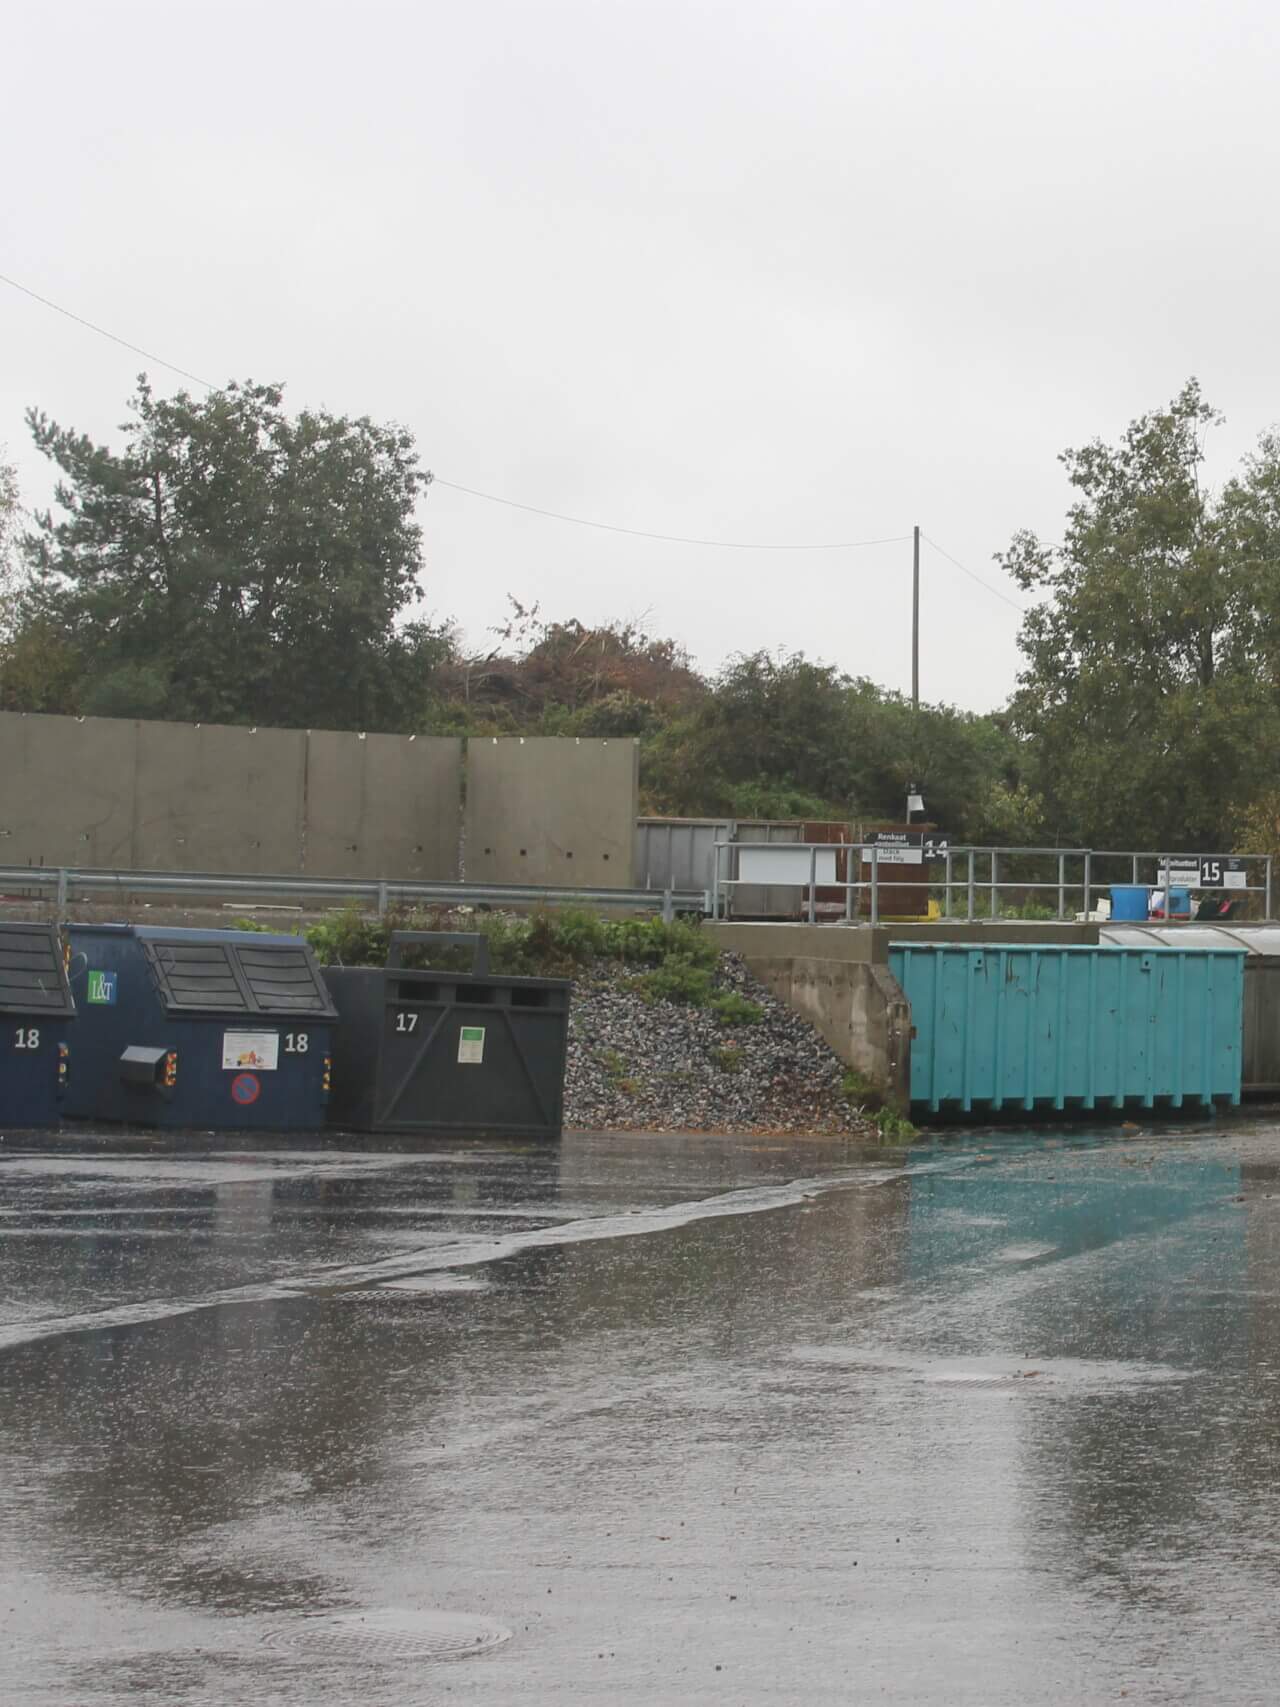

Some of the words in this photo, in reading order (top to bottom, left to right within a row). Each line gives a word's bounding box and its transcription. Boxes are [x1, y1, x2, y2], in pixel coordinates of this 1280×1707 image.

[925, 840, 948, 858] 14
[1202, 862, 1220, 882] 15
[92, 973, 113, 1001] L&T
[395, 1012, 419, 1032] 17
[15, 1028, 40, 1049] 18
[284, 1033, 309, 1053] 18
